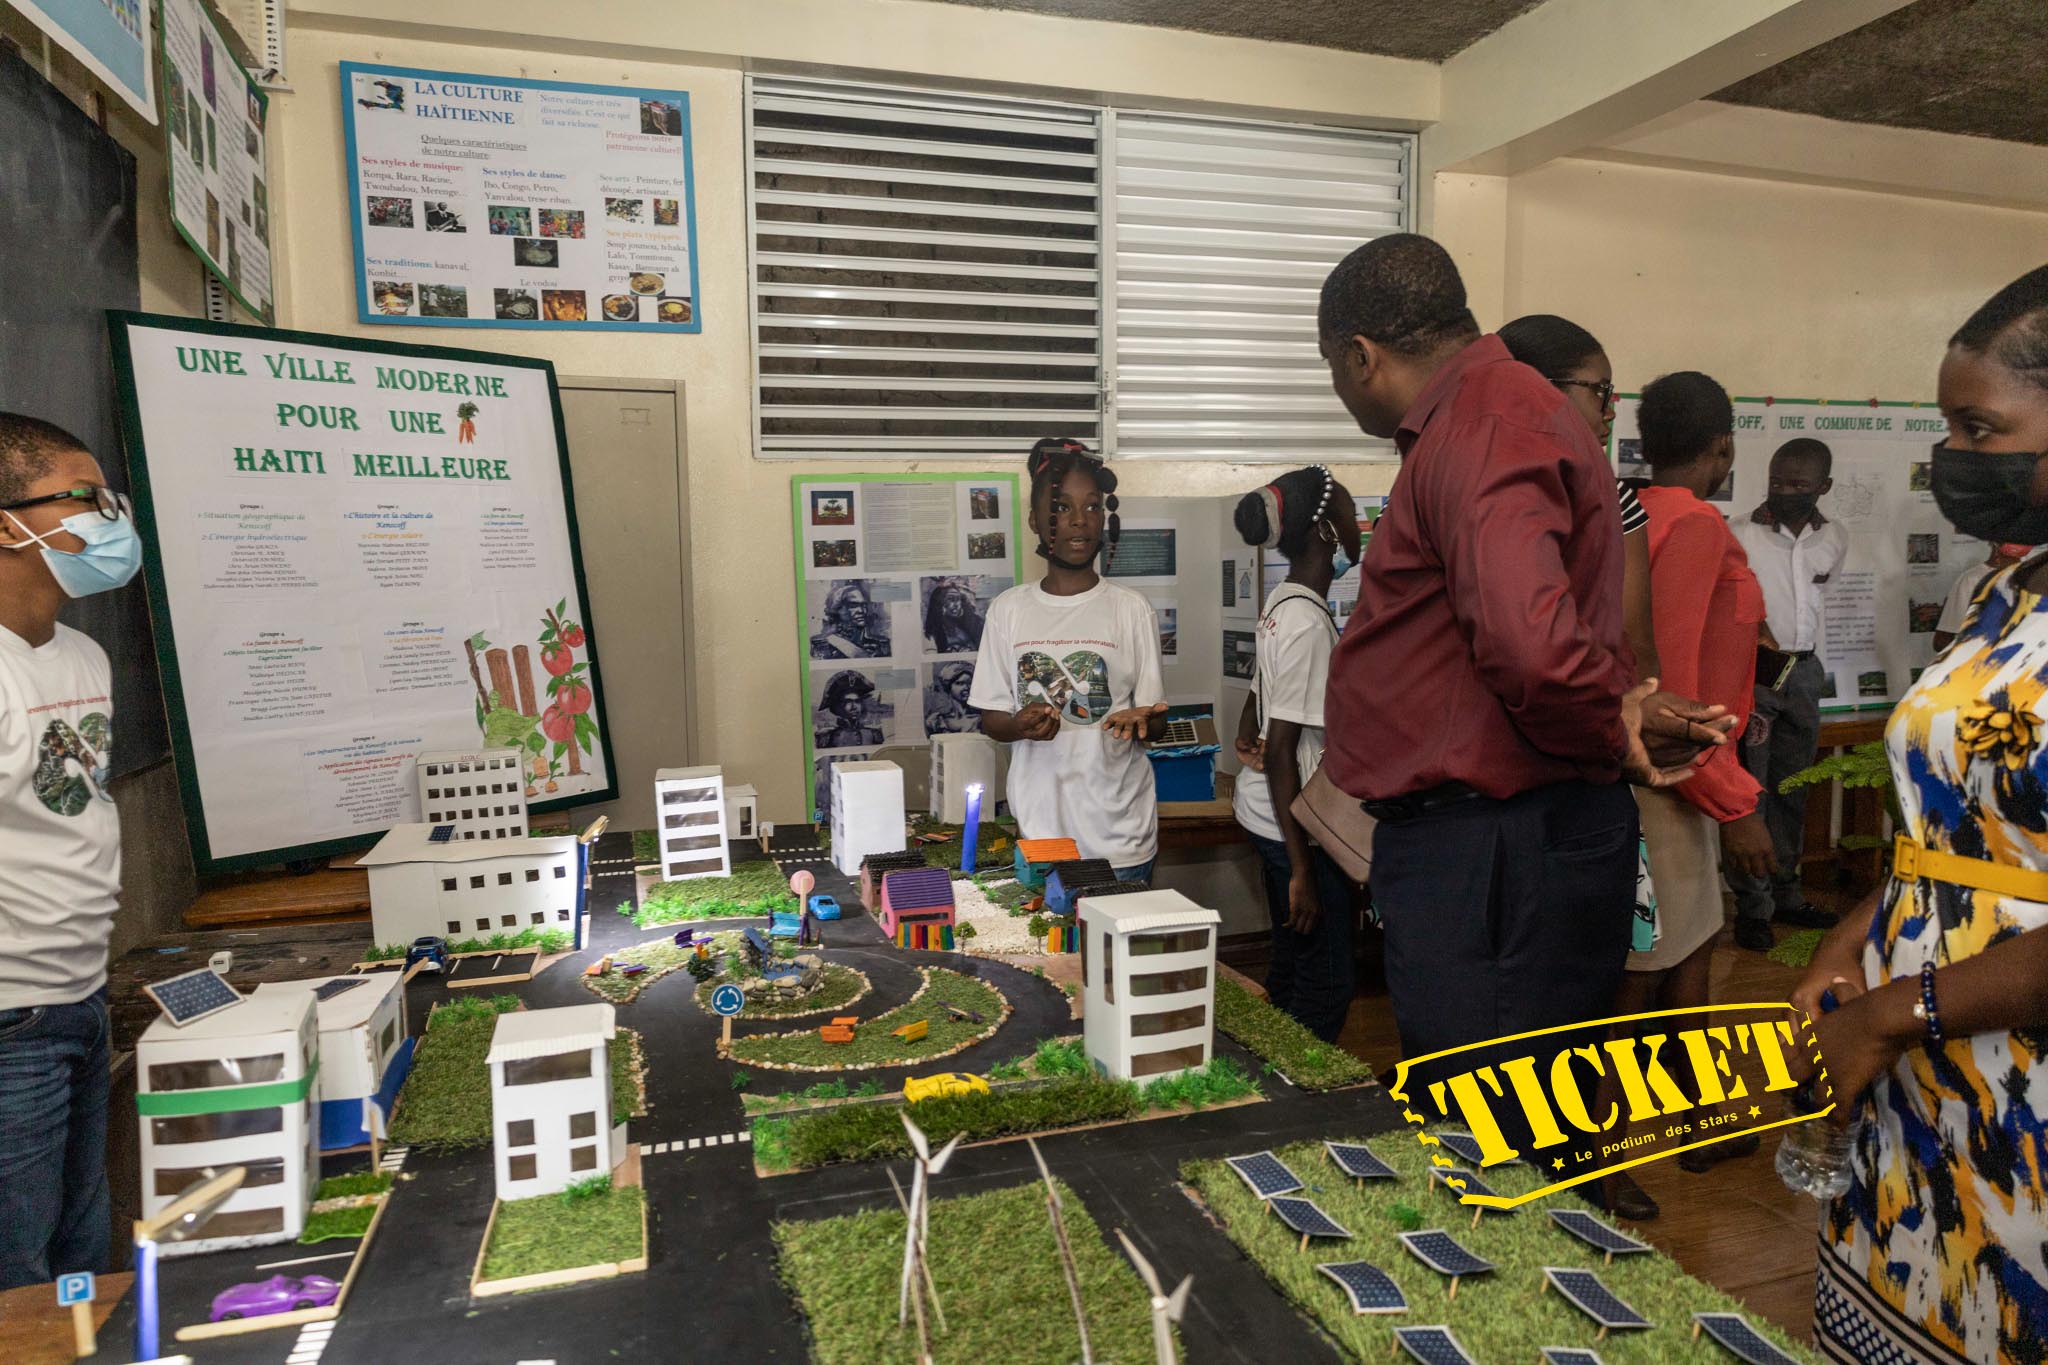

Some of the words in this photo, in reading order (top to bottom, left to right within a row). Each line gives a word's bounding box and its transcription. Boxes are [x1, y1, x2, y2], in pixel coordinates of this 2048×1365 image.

[414, 81, 437, 96] LA
[442, 82, 524, 104] CULTURE
[566, 95, 595, 106] culture
[415, 103, 516, 126] HAÏTIENNE
[421, 134, 462, 147] Quelques
[650, 133, 673, 144] notre
[421, 147, 432, 156] de
[433, 148, 457, 158] notre
[361, 155, 378, 165] Ses
[381, 158, 408, 169] styles
[409, 160, 421, 168] de
[482, 167, 498, 176] Ses
[499, 168, 526, 179] styles
[527, 170, 538, 178] de
[366, 256, 382, 266] Ses
[519, 278, 531, 287] Le
[175, 346, 248, 377] UNE
[263, 352, 357, 386] VILLE
[374, 366, 510, 400] MODERNE
[275, 402, 361, 433] POUR
[387, 409, 447, 436] UNE
[1779, 415, 1805, 431] UNE
[1814, 416, 1874, 431] COMMUNE
[1876, 417, 1893, 432] DE
[1904, 418, 1945, 433] NOTRE
[232, 446, 328, 476] HAITI
[352, 453, 512, 482] MEILLEURE
[66, 1277, 85, 1300] P
